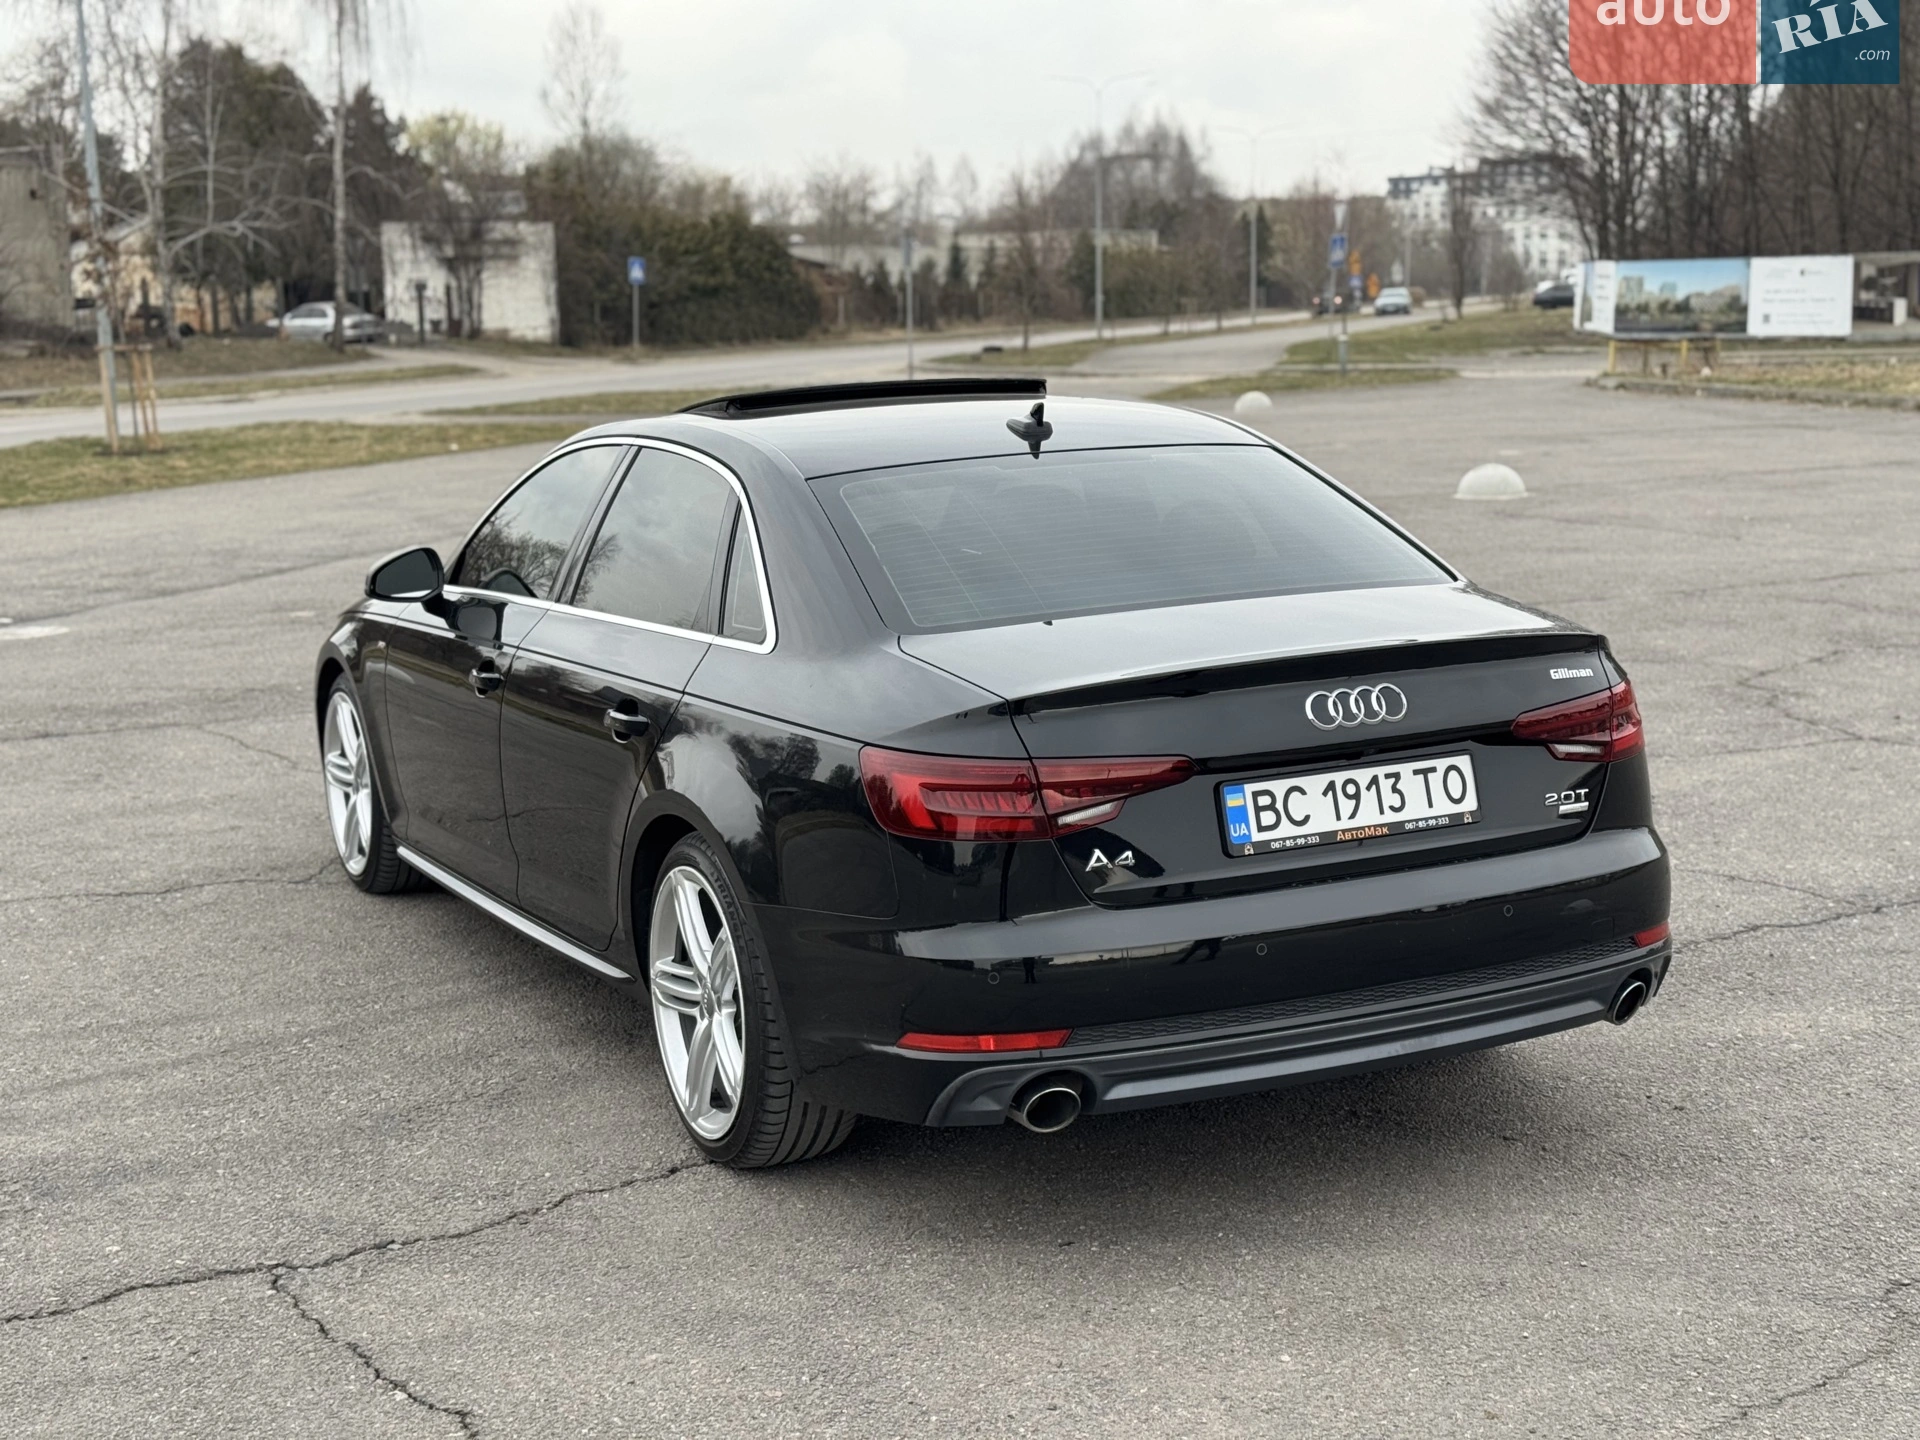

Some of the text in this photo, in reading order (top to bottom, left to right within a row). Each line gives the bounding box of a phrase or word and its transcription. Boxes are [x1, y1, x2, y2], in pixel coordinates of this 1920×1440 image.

[1550, 668, 1594, 680] Gillman
[1251, 764, 1468, 833] BC 1913 TO
[1544, 788, 1589, 806] 2.0T
[1230, 822, 1249, 837] UA
[1404, 816, 1450, 830] 067-85-99-333
[1336, 826, 1390, 841] АвтоМак
[1270, 835, 1320, 849] 067-85-99-333
[1085, 848, 1136, 872] A4
